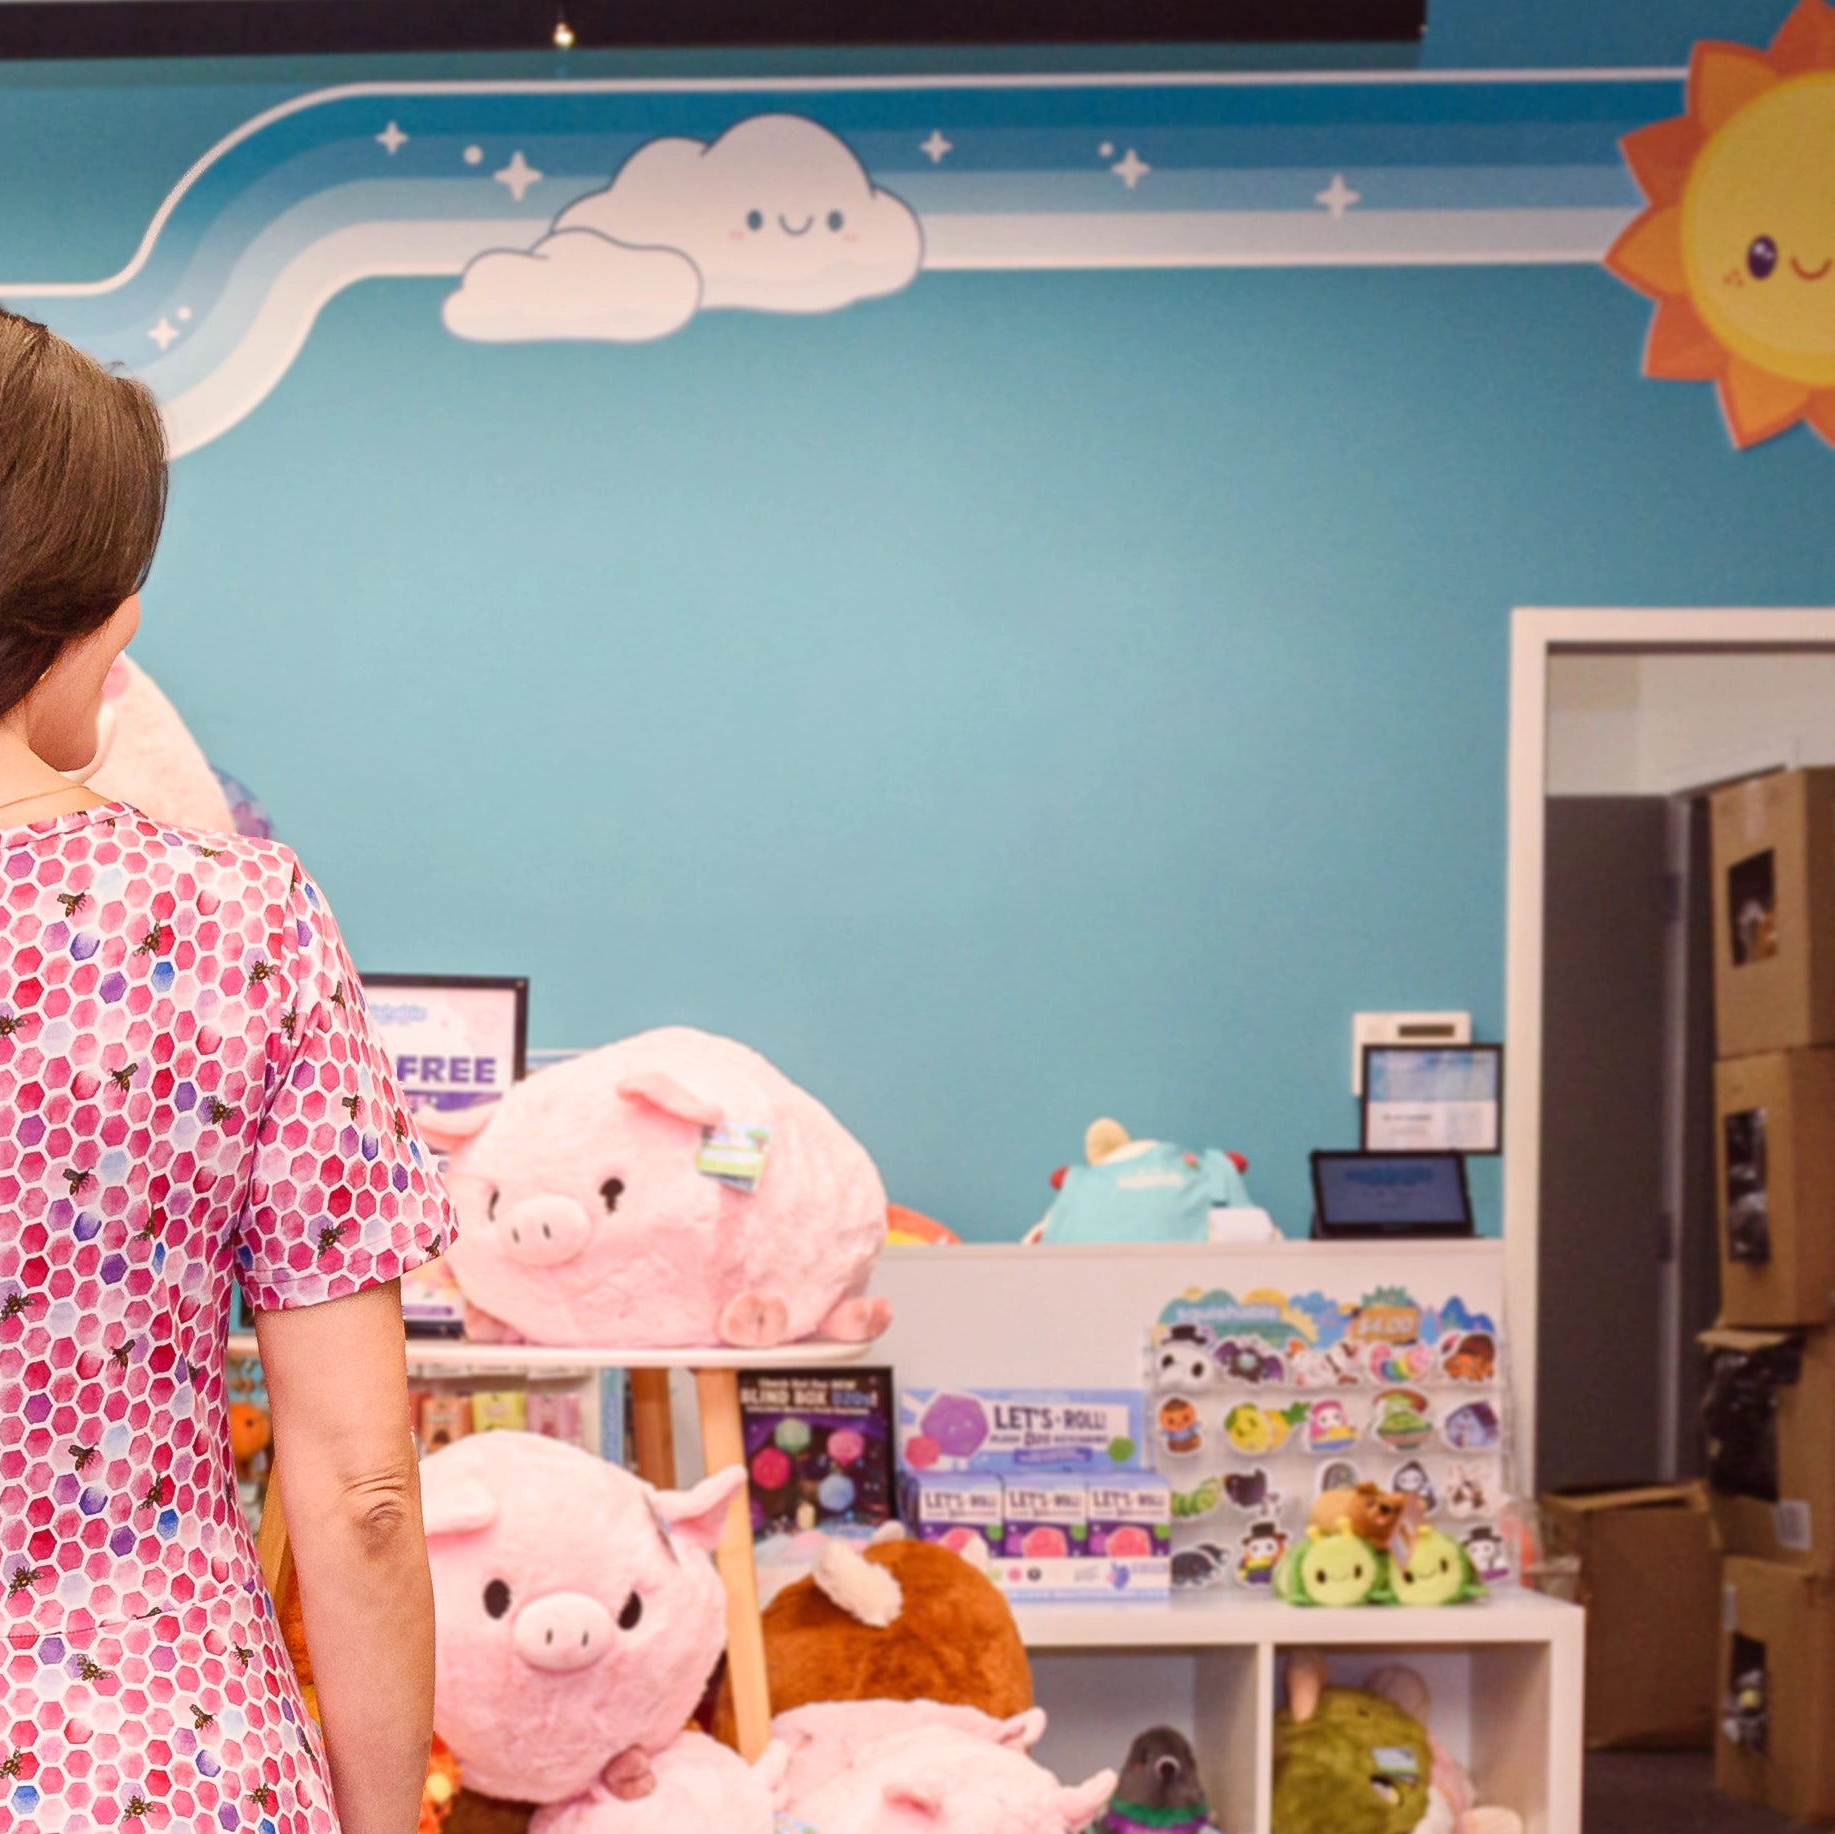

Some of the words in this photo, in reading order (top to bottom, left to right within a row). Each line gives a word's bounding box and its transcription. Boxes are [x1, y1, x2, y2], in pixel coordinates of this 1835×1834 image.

[396, 1055, 497, 1084] FREE
[1358, 1318, 1415, 1335] $4.00
[740, 1388, 790, 1405] BLIND
[793, 1389, 827, 1406] BOX
[994, 1405, 1054, 1430] LET'S
[1063, 1409, 1107, 1430] ROLL!
